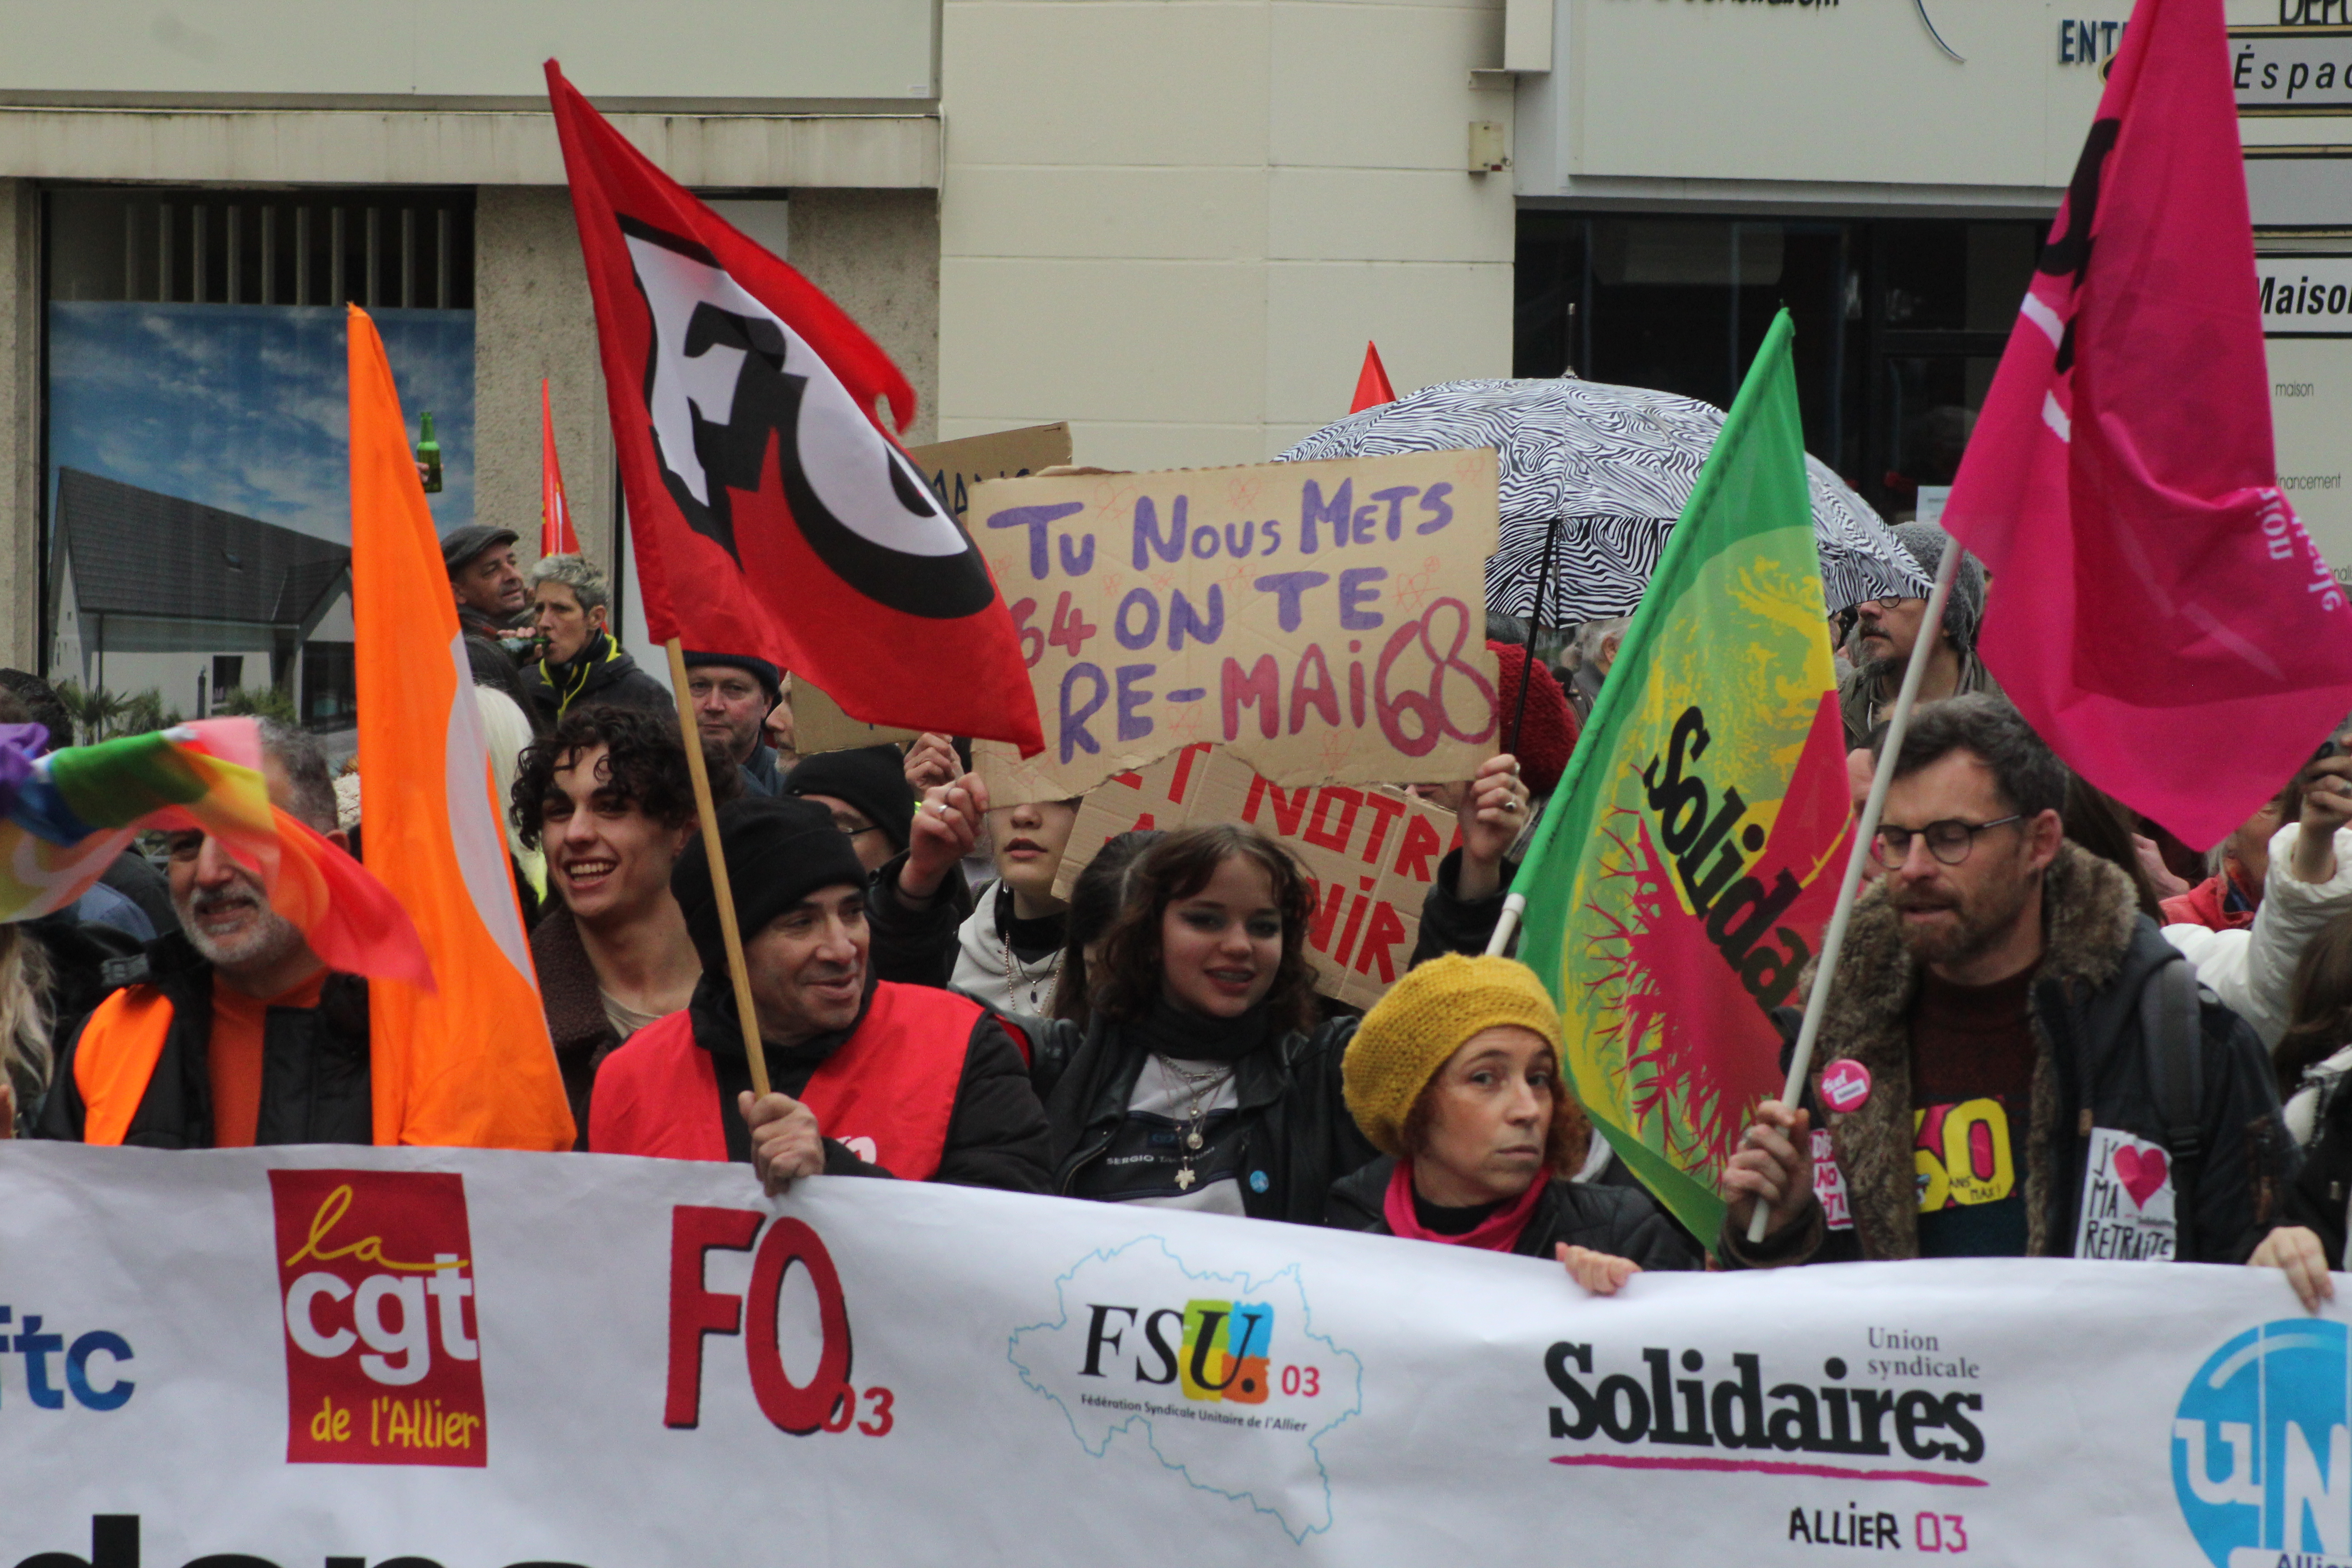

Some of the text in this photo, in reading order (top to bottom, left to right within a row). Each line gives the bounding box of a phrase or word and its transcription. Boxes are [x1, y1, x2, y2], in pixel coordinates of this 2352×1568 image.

[2062, 20, 2129, 62] ENT
[2275, 382, 2313, 397] maison
[1008, 567, 1388, 669] 64 ON TE
[1241, 771, 1462, 882] NOTR
[1643, 706, 1811, 1019] Solida
[1107, 1155, 1154, 1165] SERGIO
[2088, 1179, 2118, 1218] MA
[286, 1185, 468, 1269] la
[285, 1253, 478, 1385] cgt
[662, 1205, 853, 1436] FO
[1867, 1327, 1940, 1352] Union
[1281, 1365, 1321, 1397] 03
[1867, 1356, 1980, 1382] syndicale
[311, 1397, 479, 1448] de l'Allier
[821, 1382, 894, 1436] 03
[1081, 1393, 1308, 1432] Fédération Syndicale Unitaire de l'Allier
[1544, 1341, 1985, 1464] Solidaires
[1915, 1512, 1968, 1553] 03
